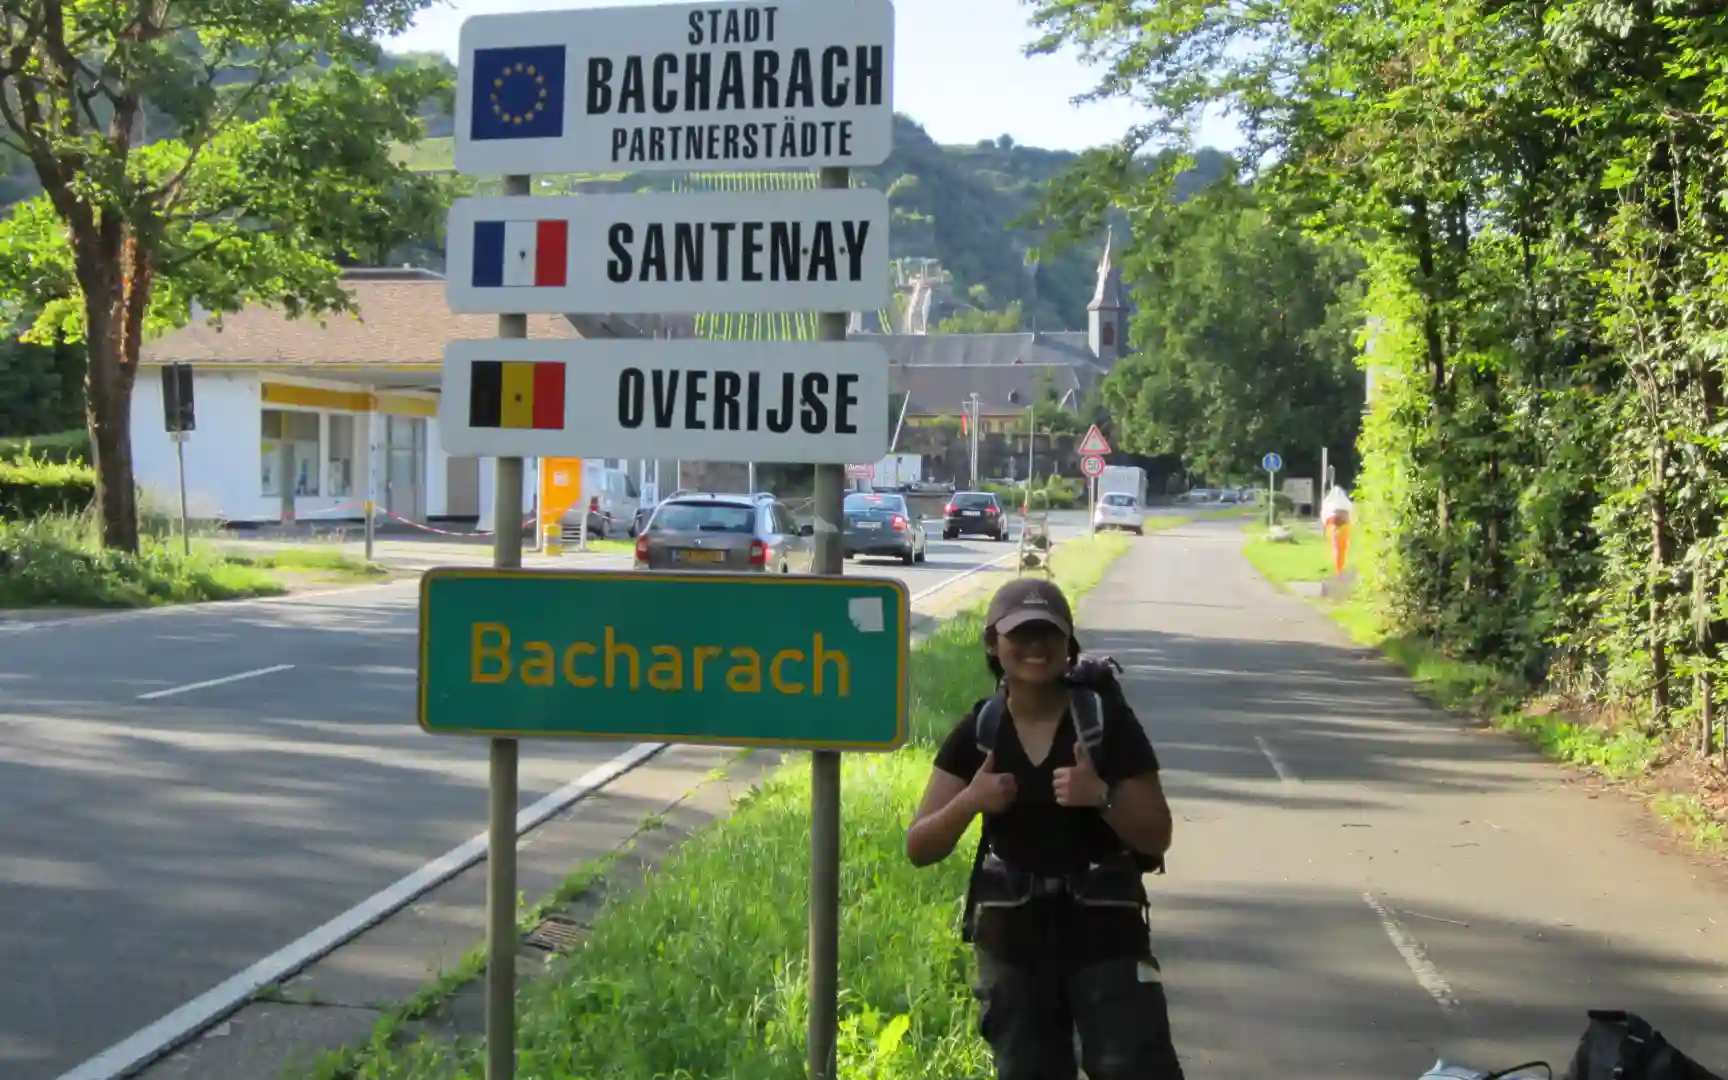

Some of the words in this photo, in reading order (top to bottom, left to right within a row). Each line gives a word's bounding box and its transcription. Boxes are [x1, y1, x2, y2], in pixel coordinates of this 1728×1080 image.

[688, 7, 778, 45] STADT
[586, 45, 883, 115] BACHARACH
[611, 116, 853, 162] PARTNERSTÄDTE
[607, 220, 870, 283] SANTENAY
[618, 367, 859, 435] OVERIJSE
[470, 621, 851, 697] Bacharach
